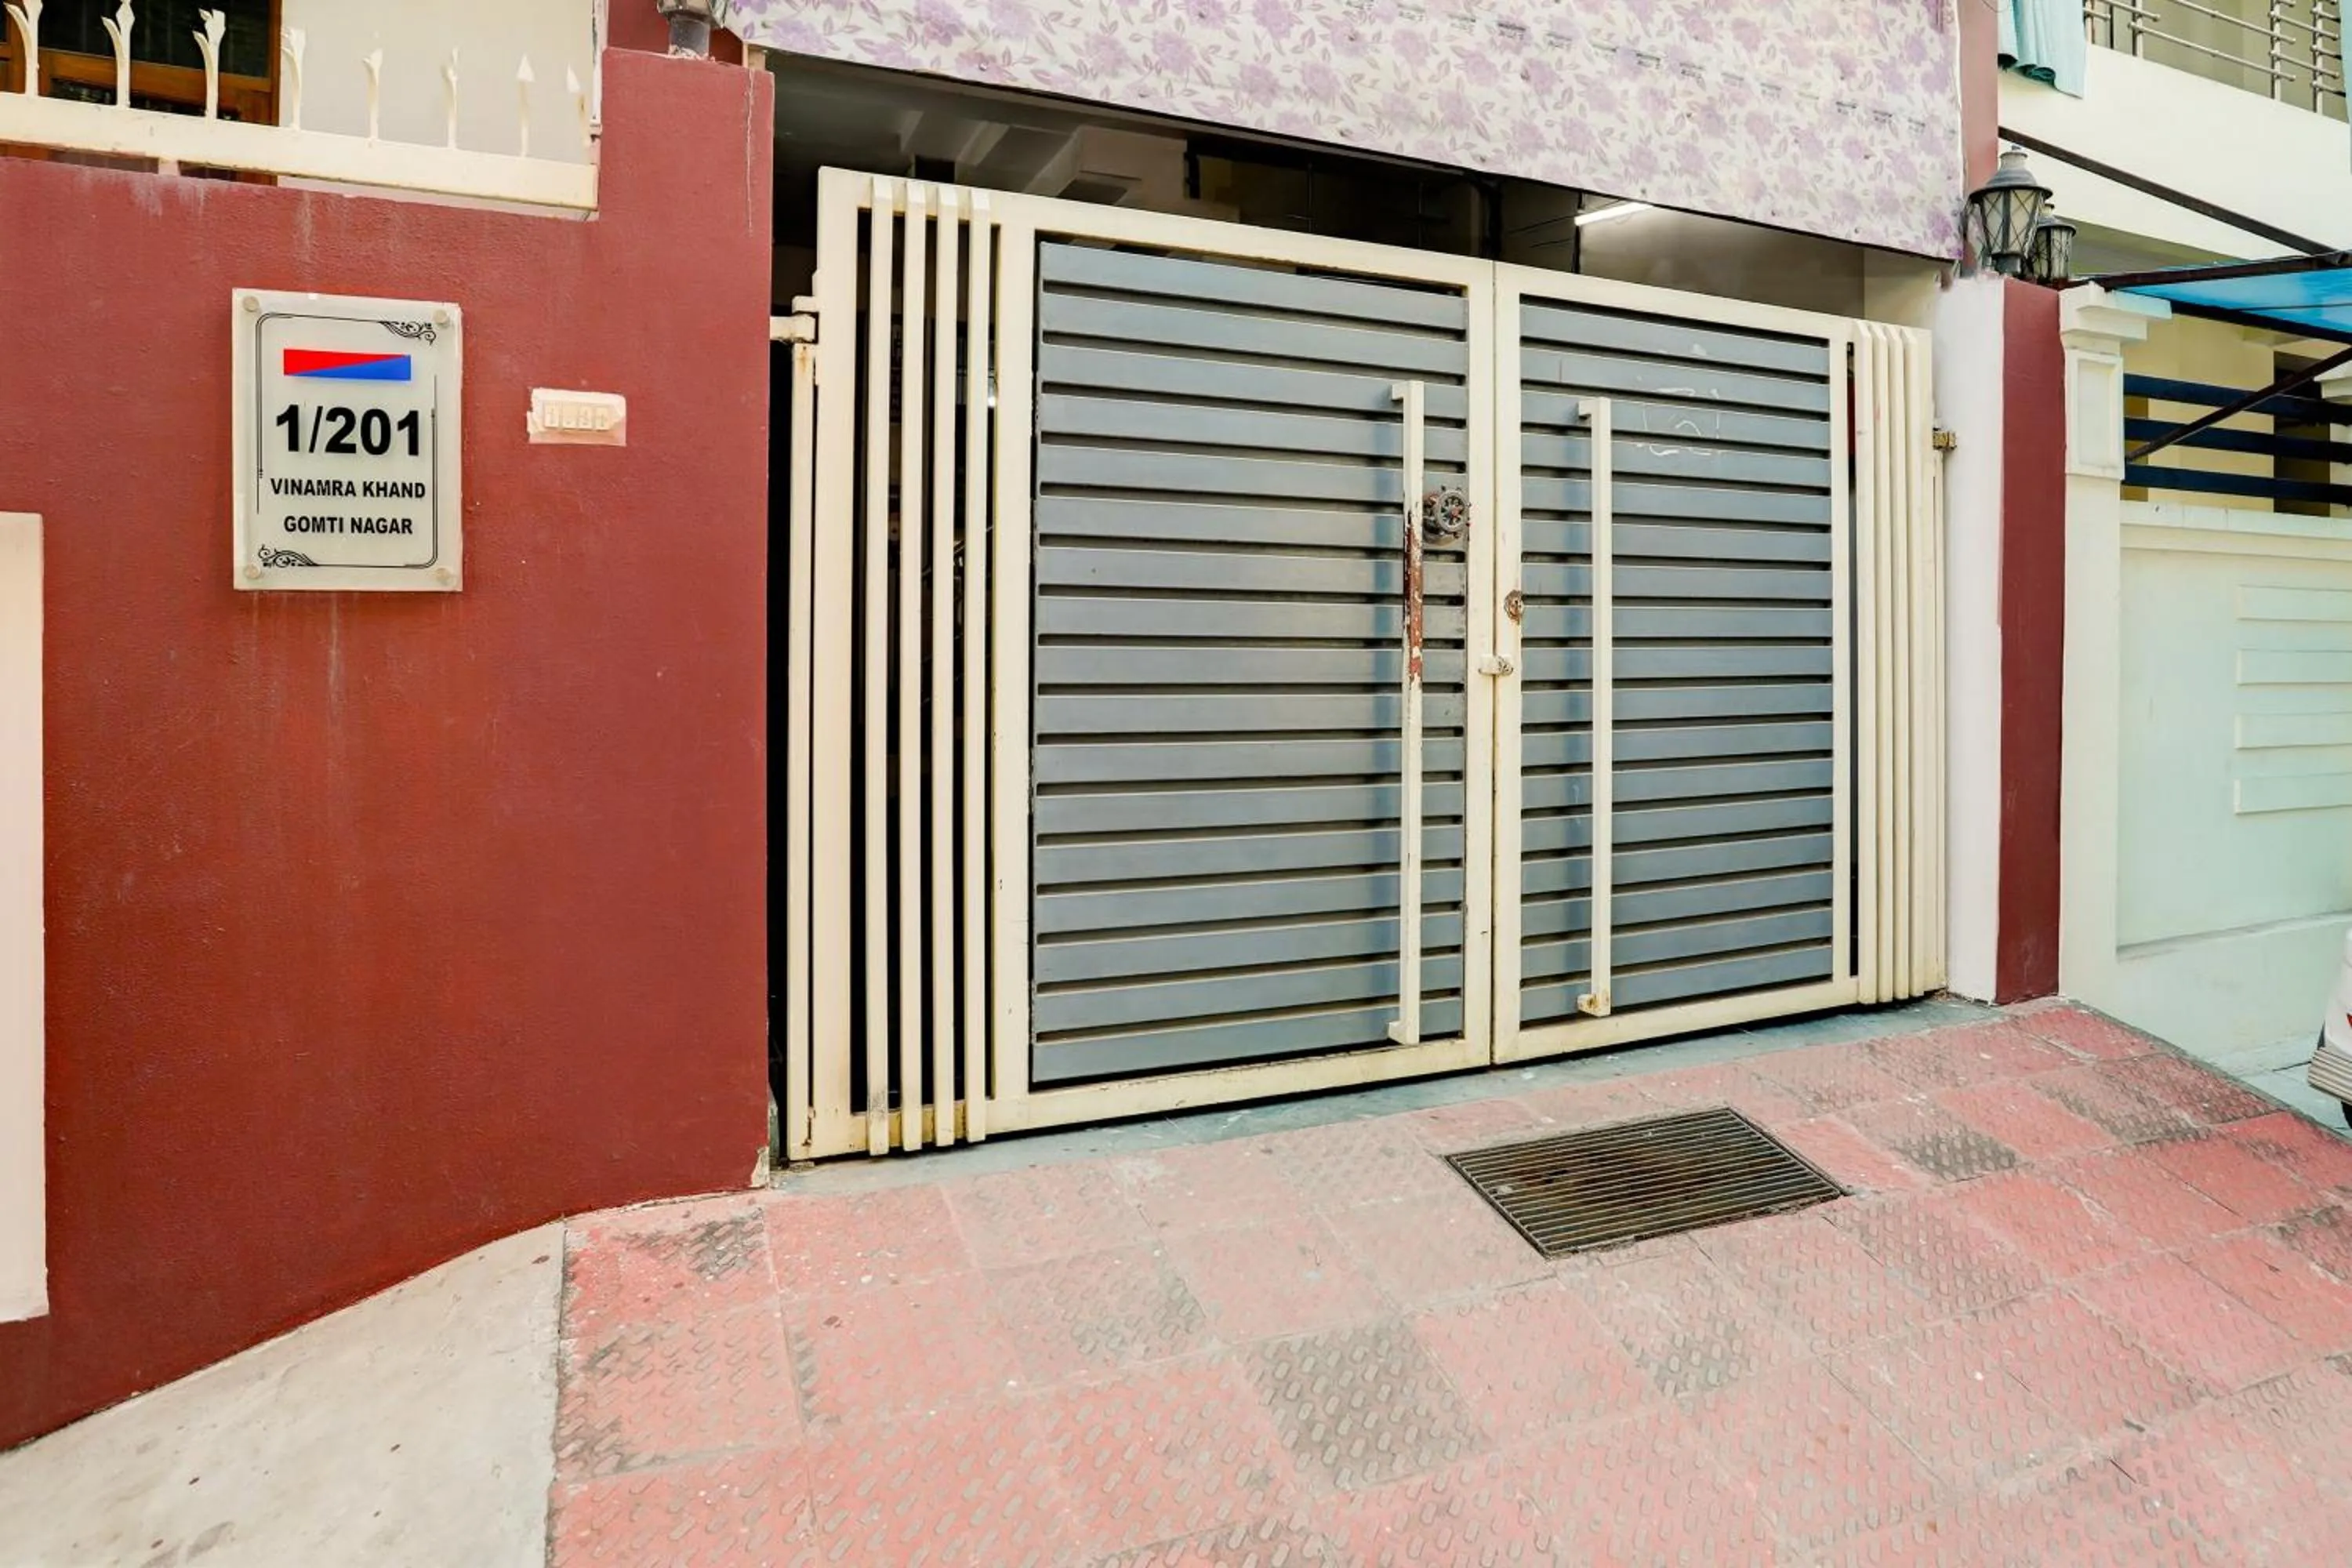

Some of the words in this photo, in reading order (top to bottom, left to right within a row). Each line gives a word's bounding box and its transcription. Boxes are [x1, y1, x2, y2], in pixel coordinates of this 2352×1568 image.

[276, 404, 419, 456] 1/201
[270, 477, 357, 498] VINAMRA
[362, 481, 426, 499] KHAND
[283, 515, 344, 534] GOMTI
[350, 517, 413, 535] NAGAR
